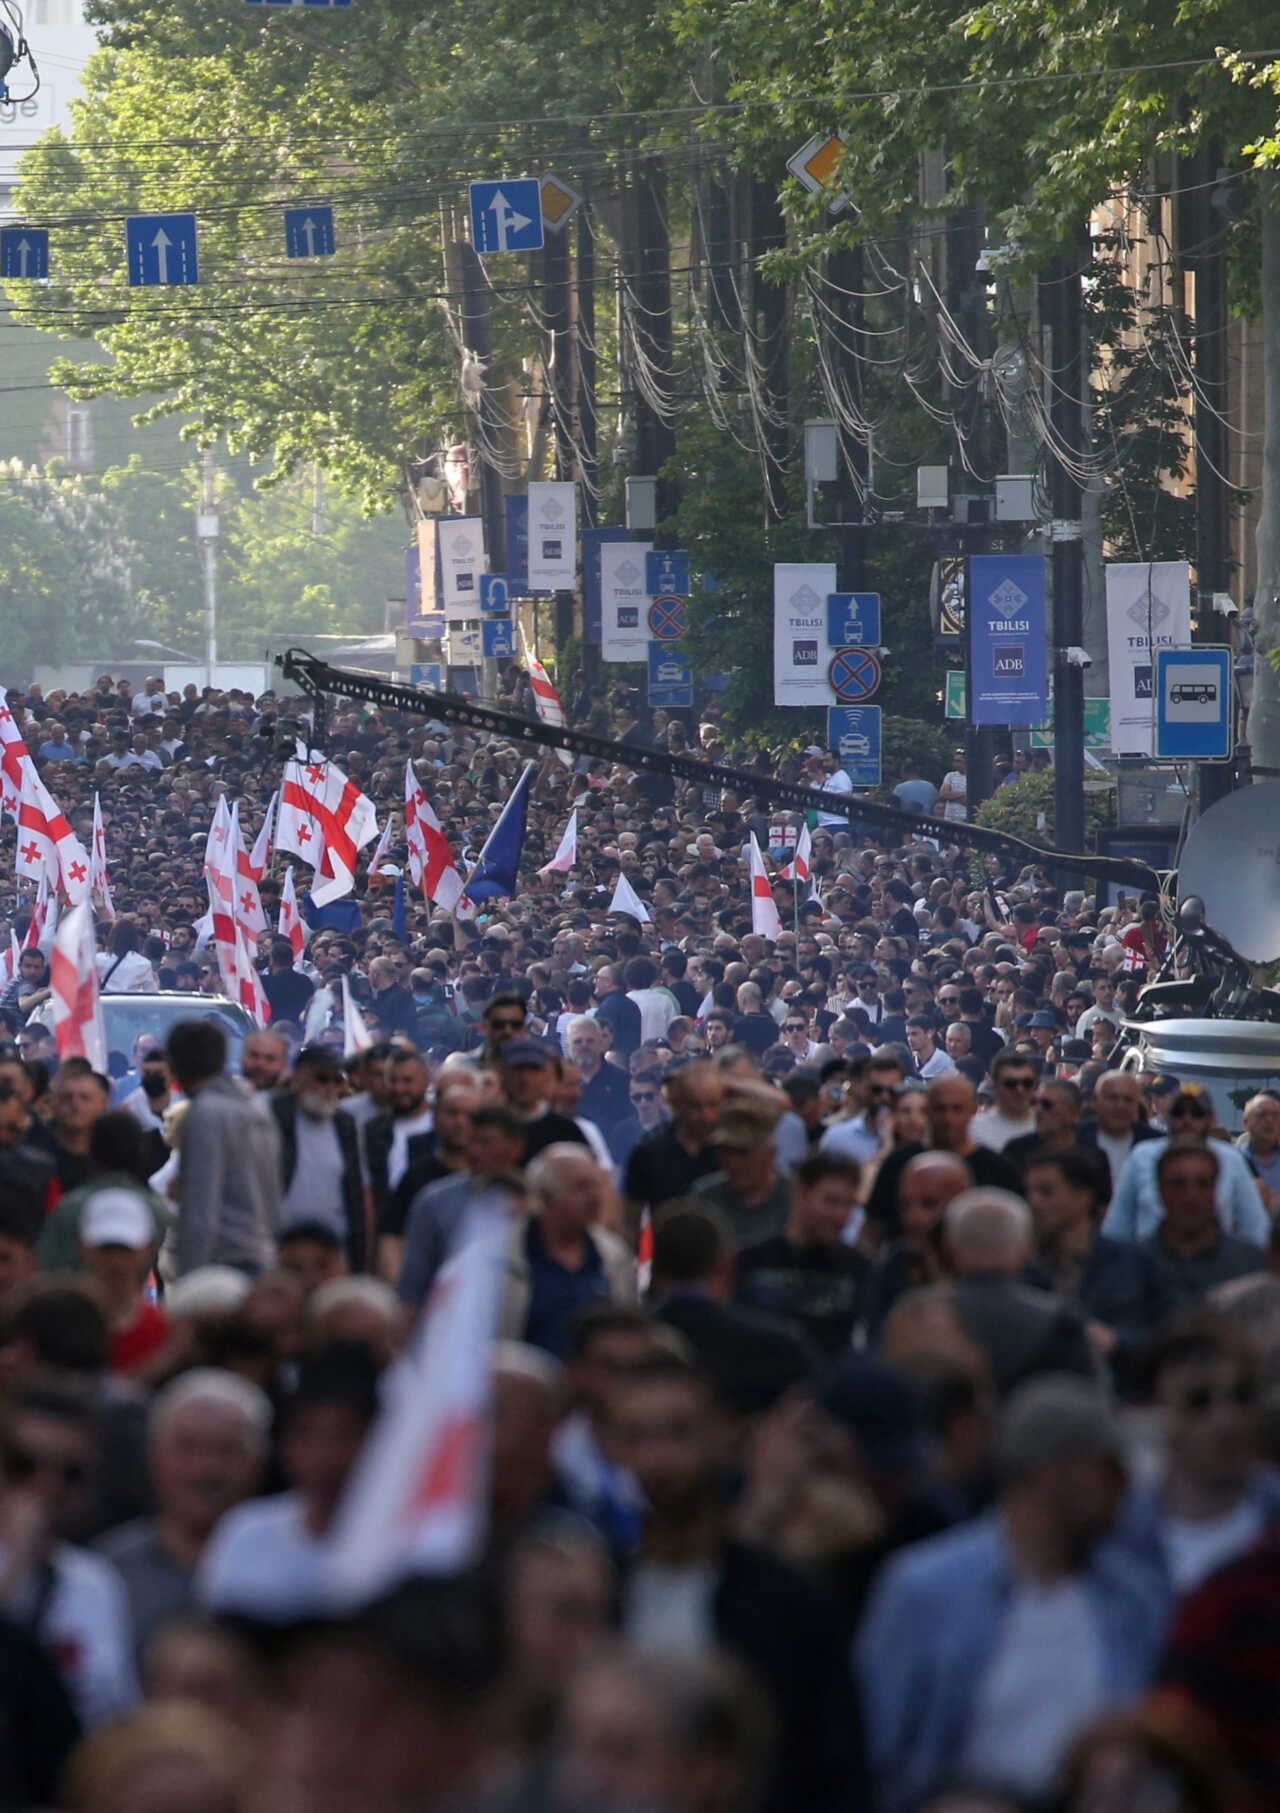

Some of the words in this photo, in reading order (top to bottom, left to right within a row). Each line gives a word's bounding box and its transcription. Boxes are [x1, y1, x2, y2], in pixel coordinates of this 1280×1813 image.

[789, 618, 823, 627] TBILISI
[987, 620, 1030, 631] TBILISI
[794, 649, 817, 661] ADB
[994, 659, 1024, 671] ADB
